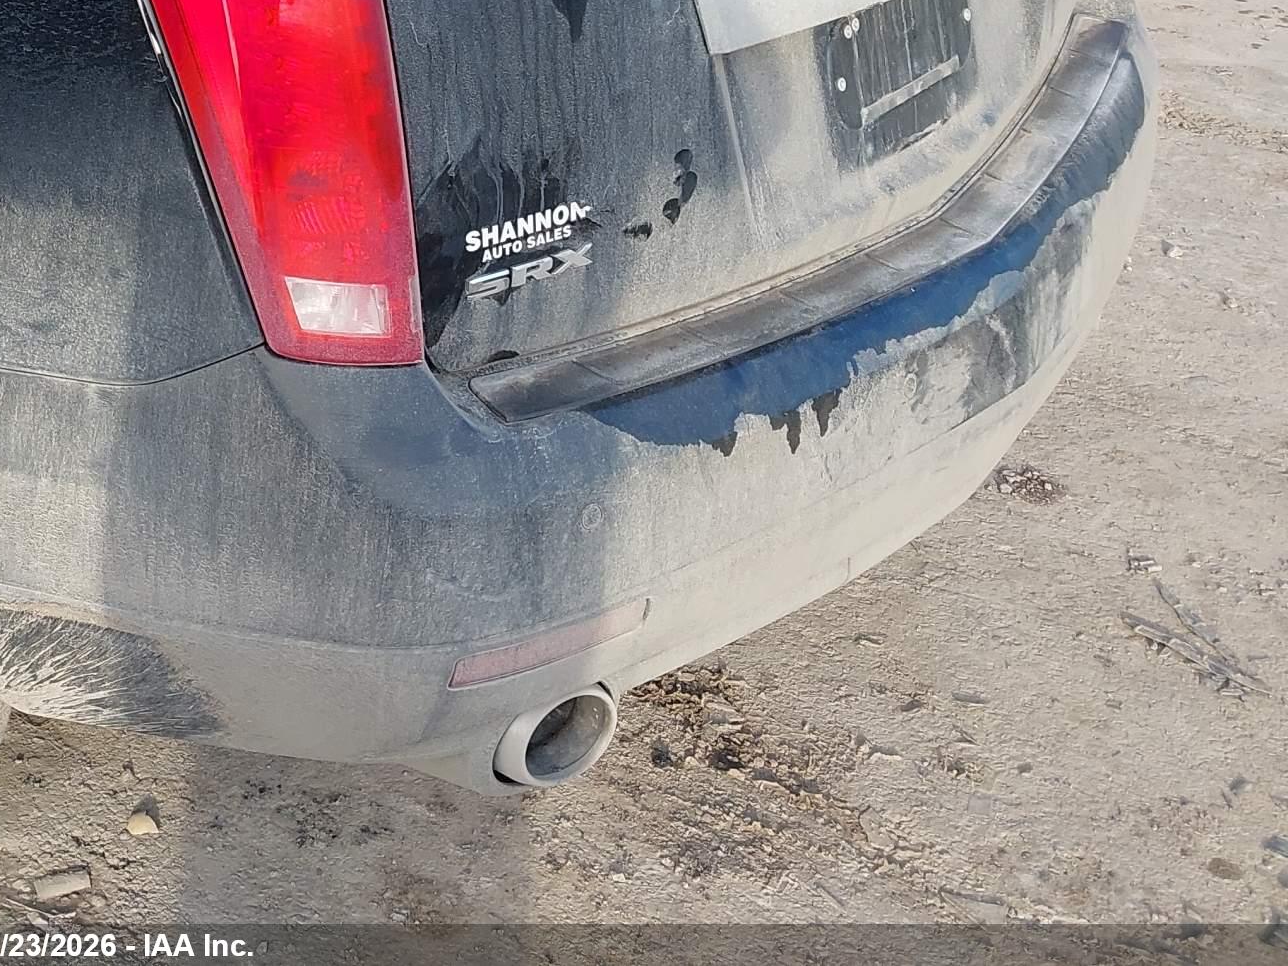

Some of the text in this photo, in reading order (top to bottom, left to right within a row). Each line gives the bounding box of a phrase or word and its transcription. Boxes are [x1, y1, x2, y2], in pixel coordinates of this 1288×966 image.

[465, 200, 592, 252] SHANNON
[482, 225, 572, 263] AUTO SALES
[465, 242, 593, 299] SRX
